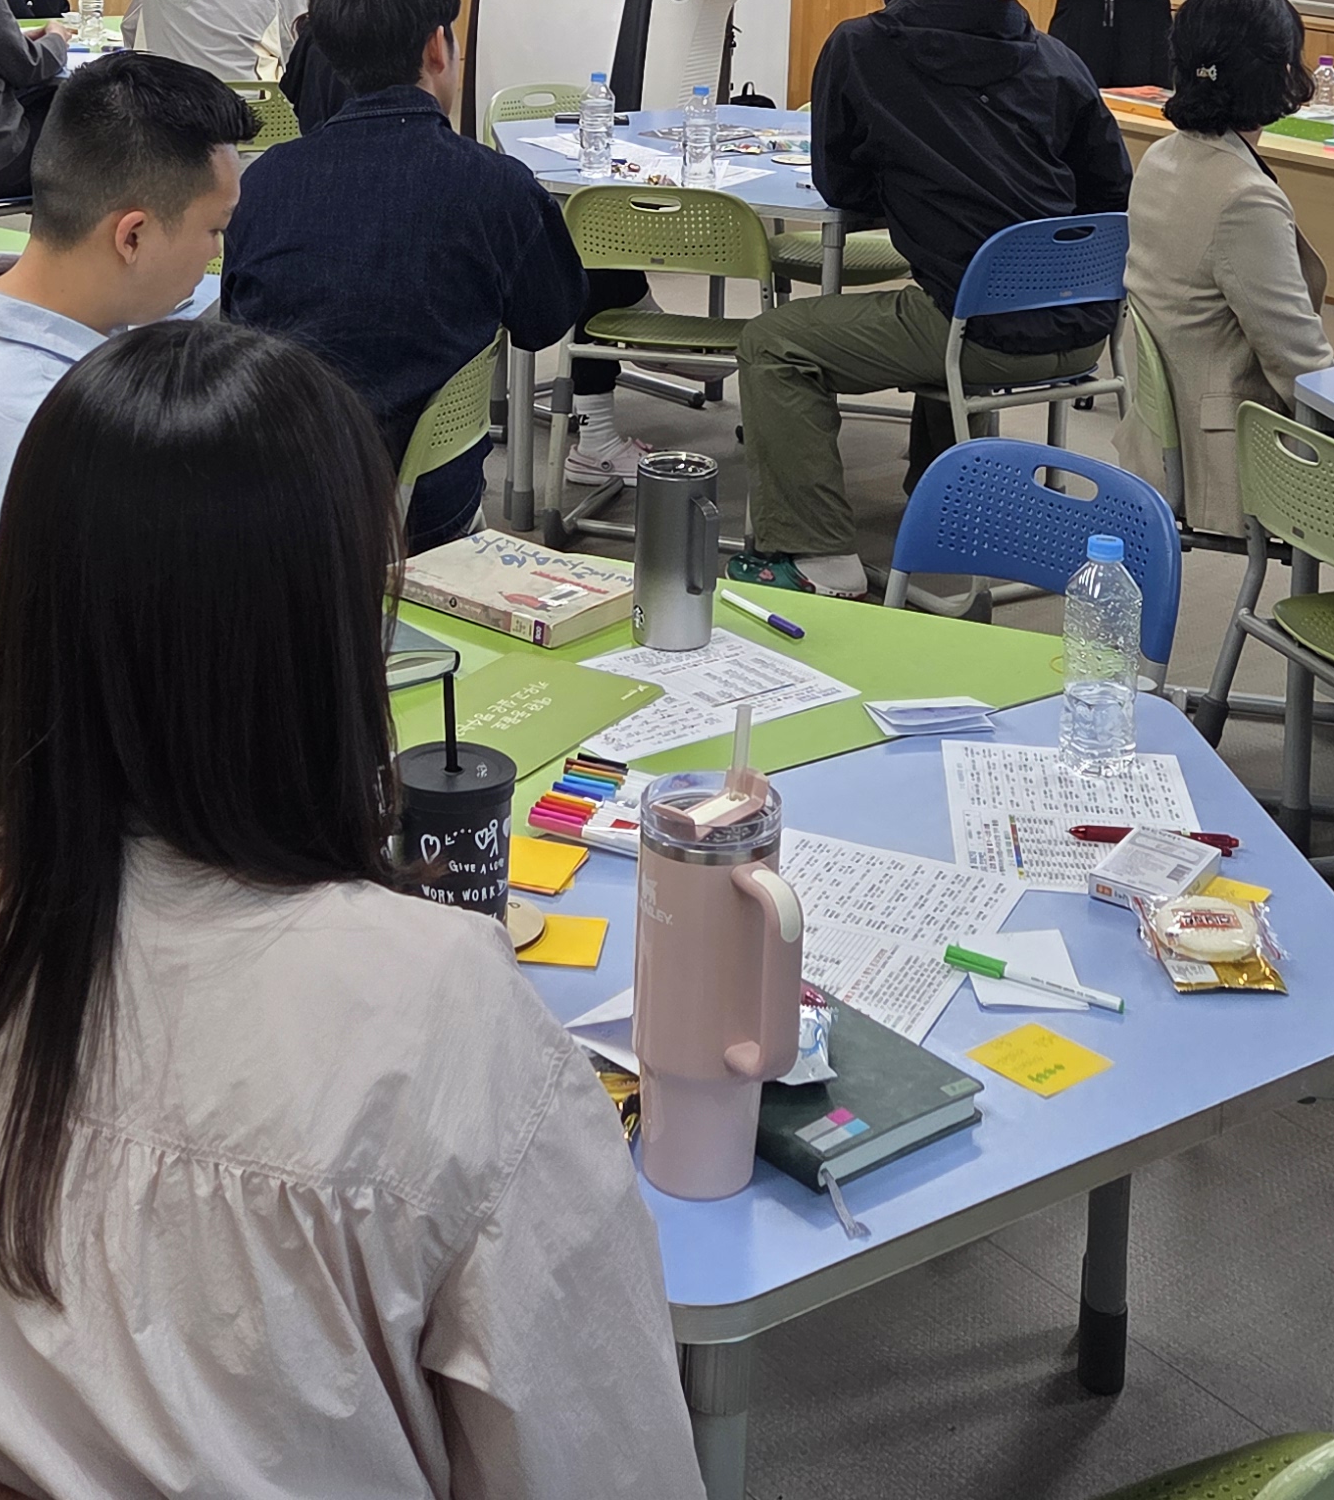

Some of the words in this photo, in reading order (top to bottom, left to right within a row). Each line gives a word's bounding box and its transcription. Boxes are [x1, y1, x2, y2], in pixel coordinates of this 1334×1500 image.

[448, 859, 476, 873] GIVE
[421, 884, 455, 903] WORK
[462, 885, 496, 902] WORK
